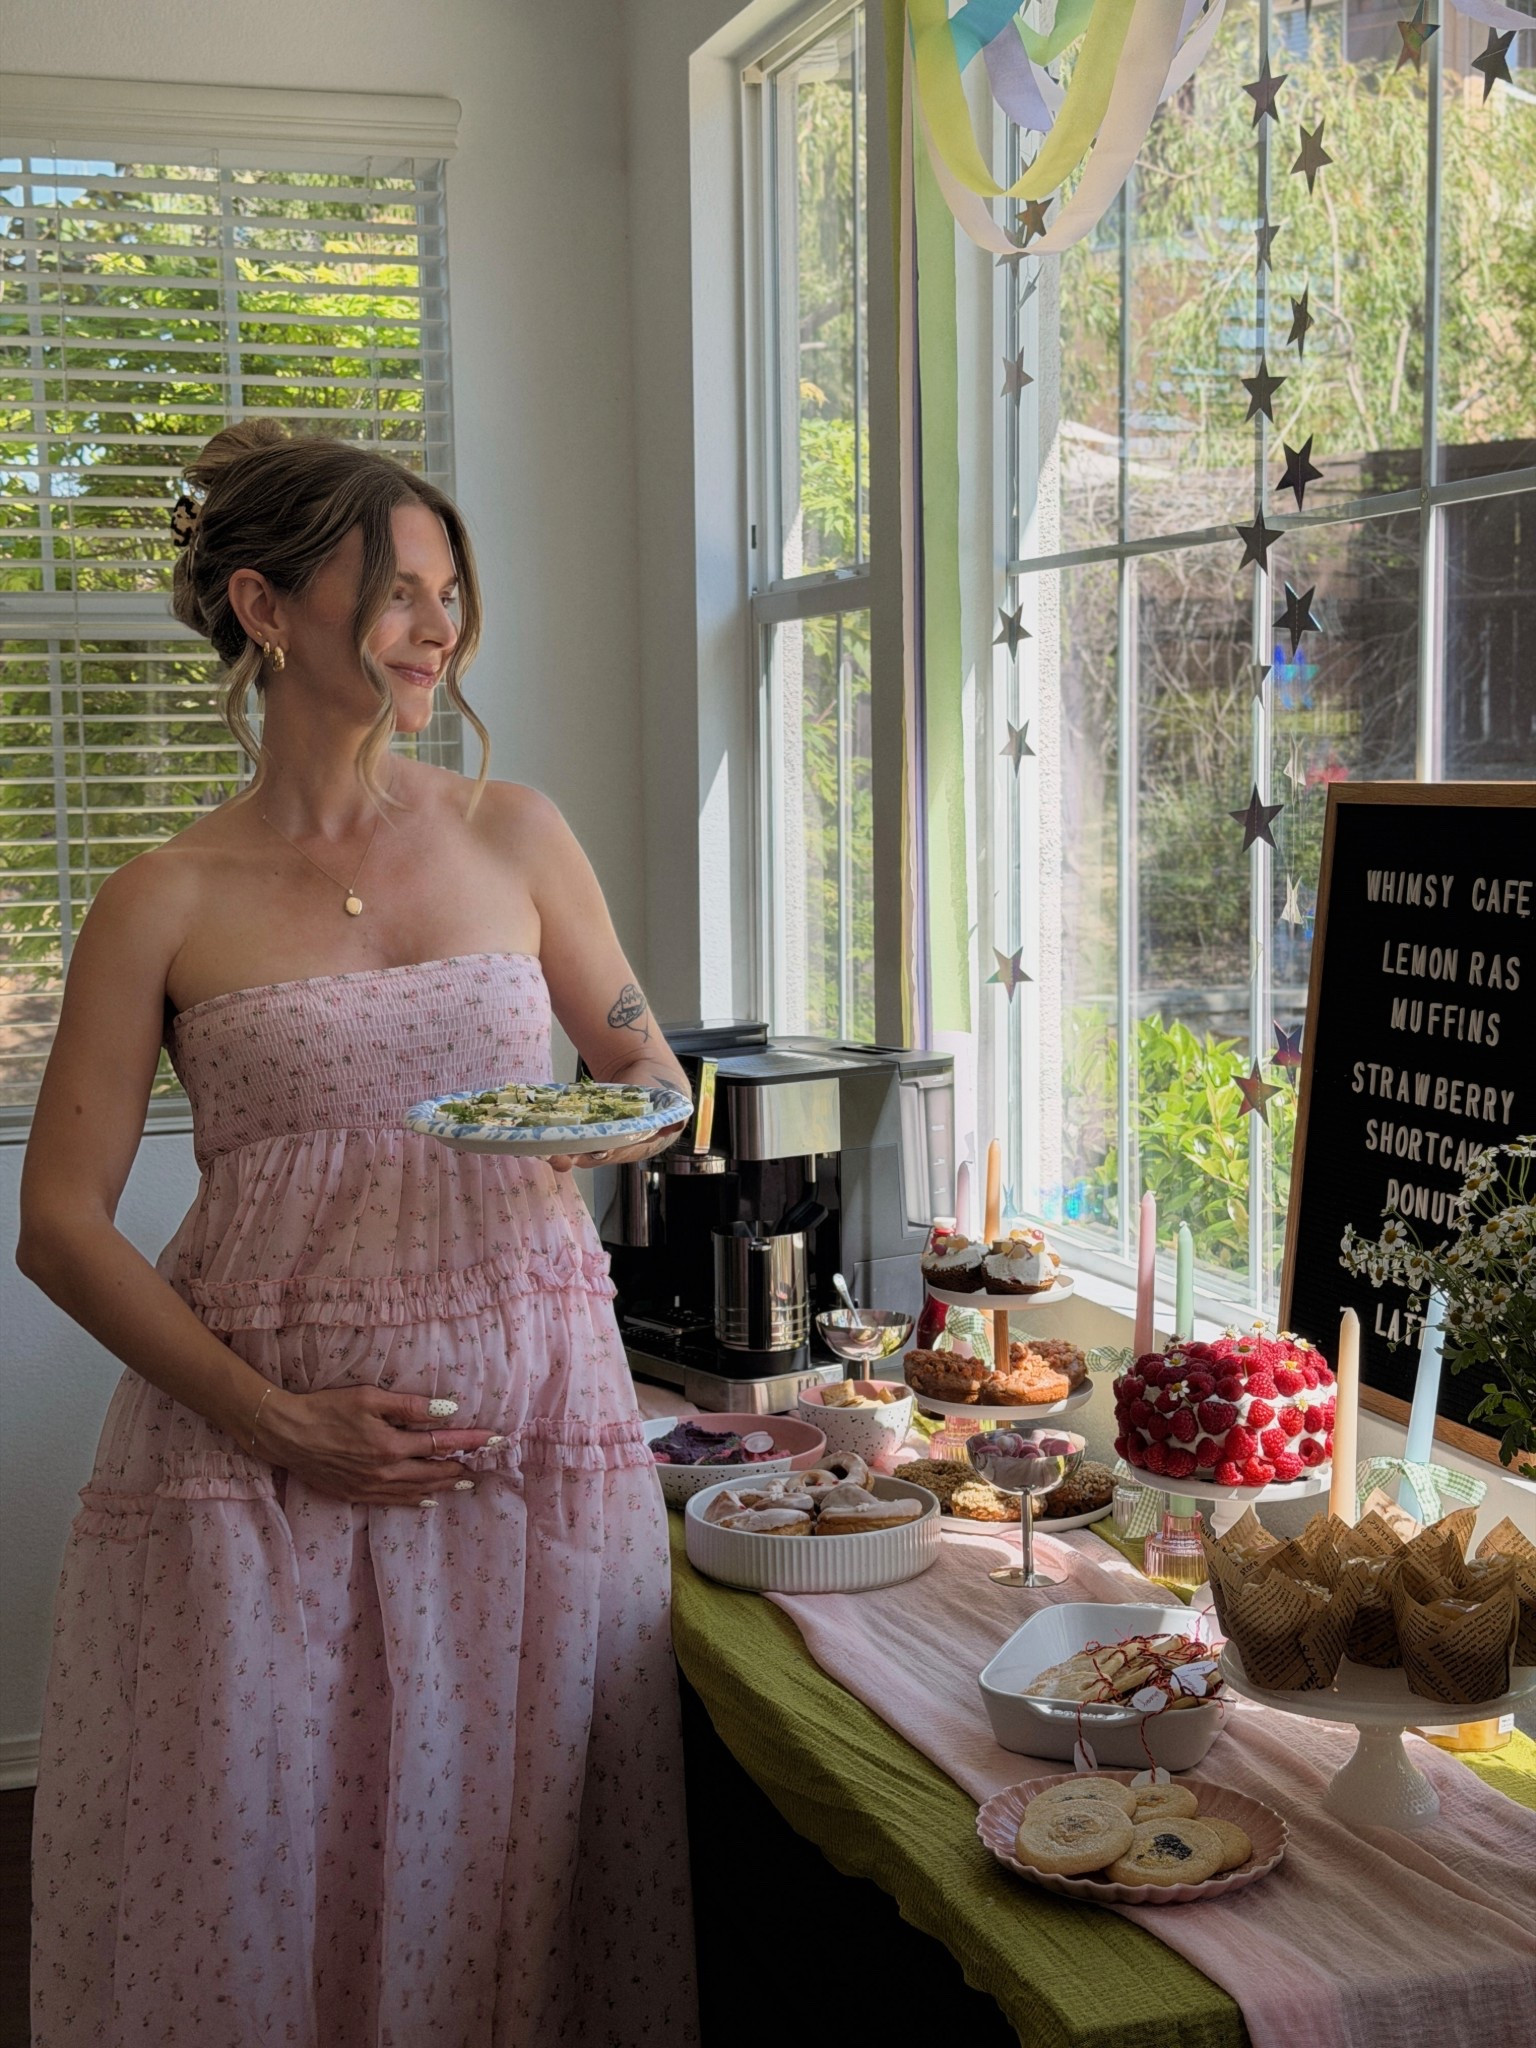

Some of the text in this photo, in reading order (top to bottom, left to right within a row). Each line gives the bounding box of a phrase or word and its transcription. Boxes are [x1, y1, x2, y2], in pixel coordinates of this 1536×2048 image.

[1367, 870, 1533, 917] WHIMSY CAFE
[1382, 940, 1520, 991] LEMON RAS
[1390, 997, 1500, 1046] MUFFINS
[1352, 1061, 1514, 1125] STRAWBERRY
[1365, 1118, 1492, 1176] SHORTCAK
[1375, 1302, 1430, 1350] LATT
